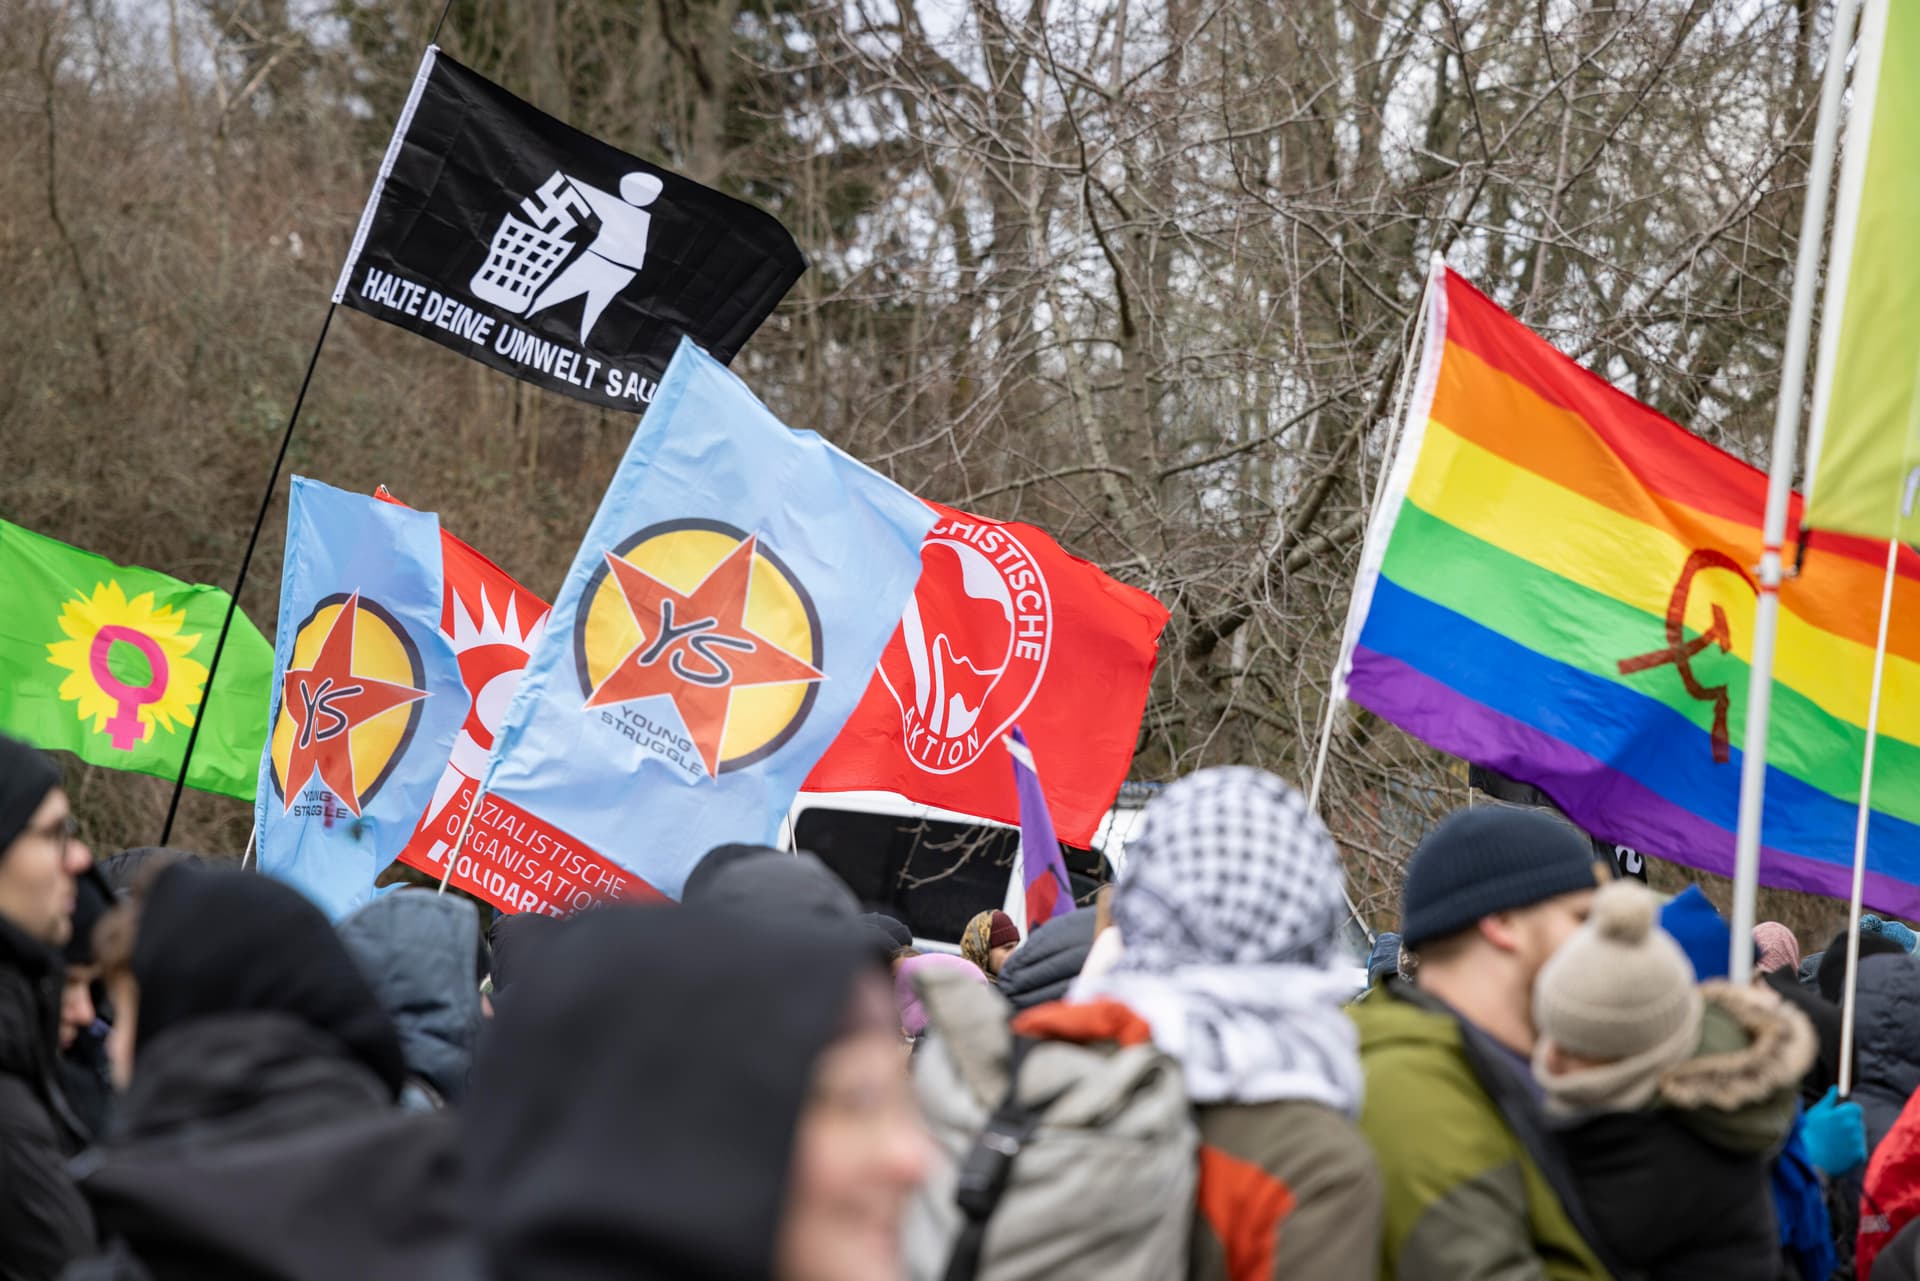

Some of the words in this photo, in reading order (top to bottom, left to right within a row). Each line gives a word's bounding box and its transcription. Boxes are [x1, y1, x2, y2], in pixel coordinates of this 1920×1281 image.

[361, 267, 428, 316] HALTE
[421, 291, 496, 346] DEINE
[494, 324, 601, 389] UMWELT
[605, 368, 657, 403] SAU
[638, 599, 756, 687] YS
[300, 678, 364, 749] YS
[601, 711, 703, 777] STRUGGLE
[621, 706, 693, 753] YOUNG
[904, 706, 980, 766] AKTION
[459, 788, 627, 900] SOZIALISTISCHE
[443, 848, 574, 919] SOLIDARIT
